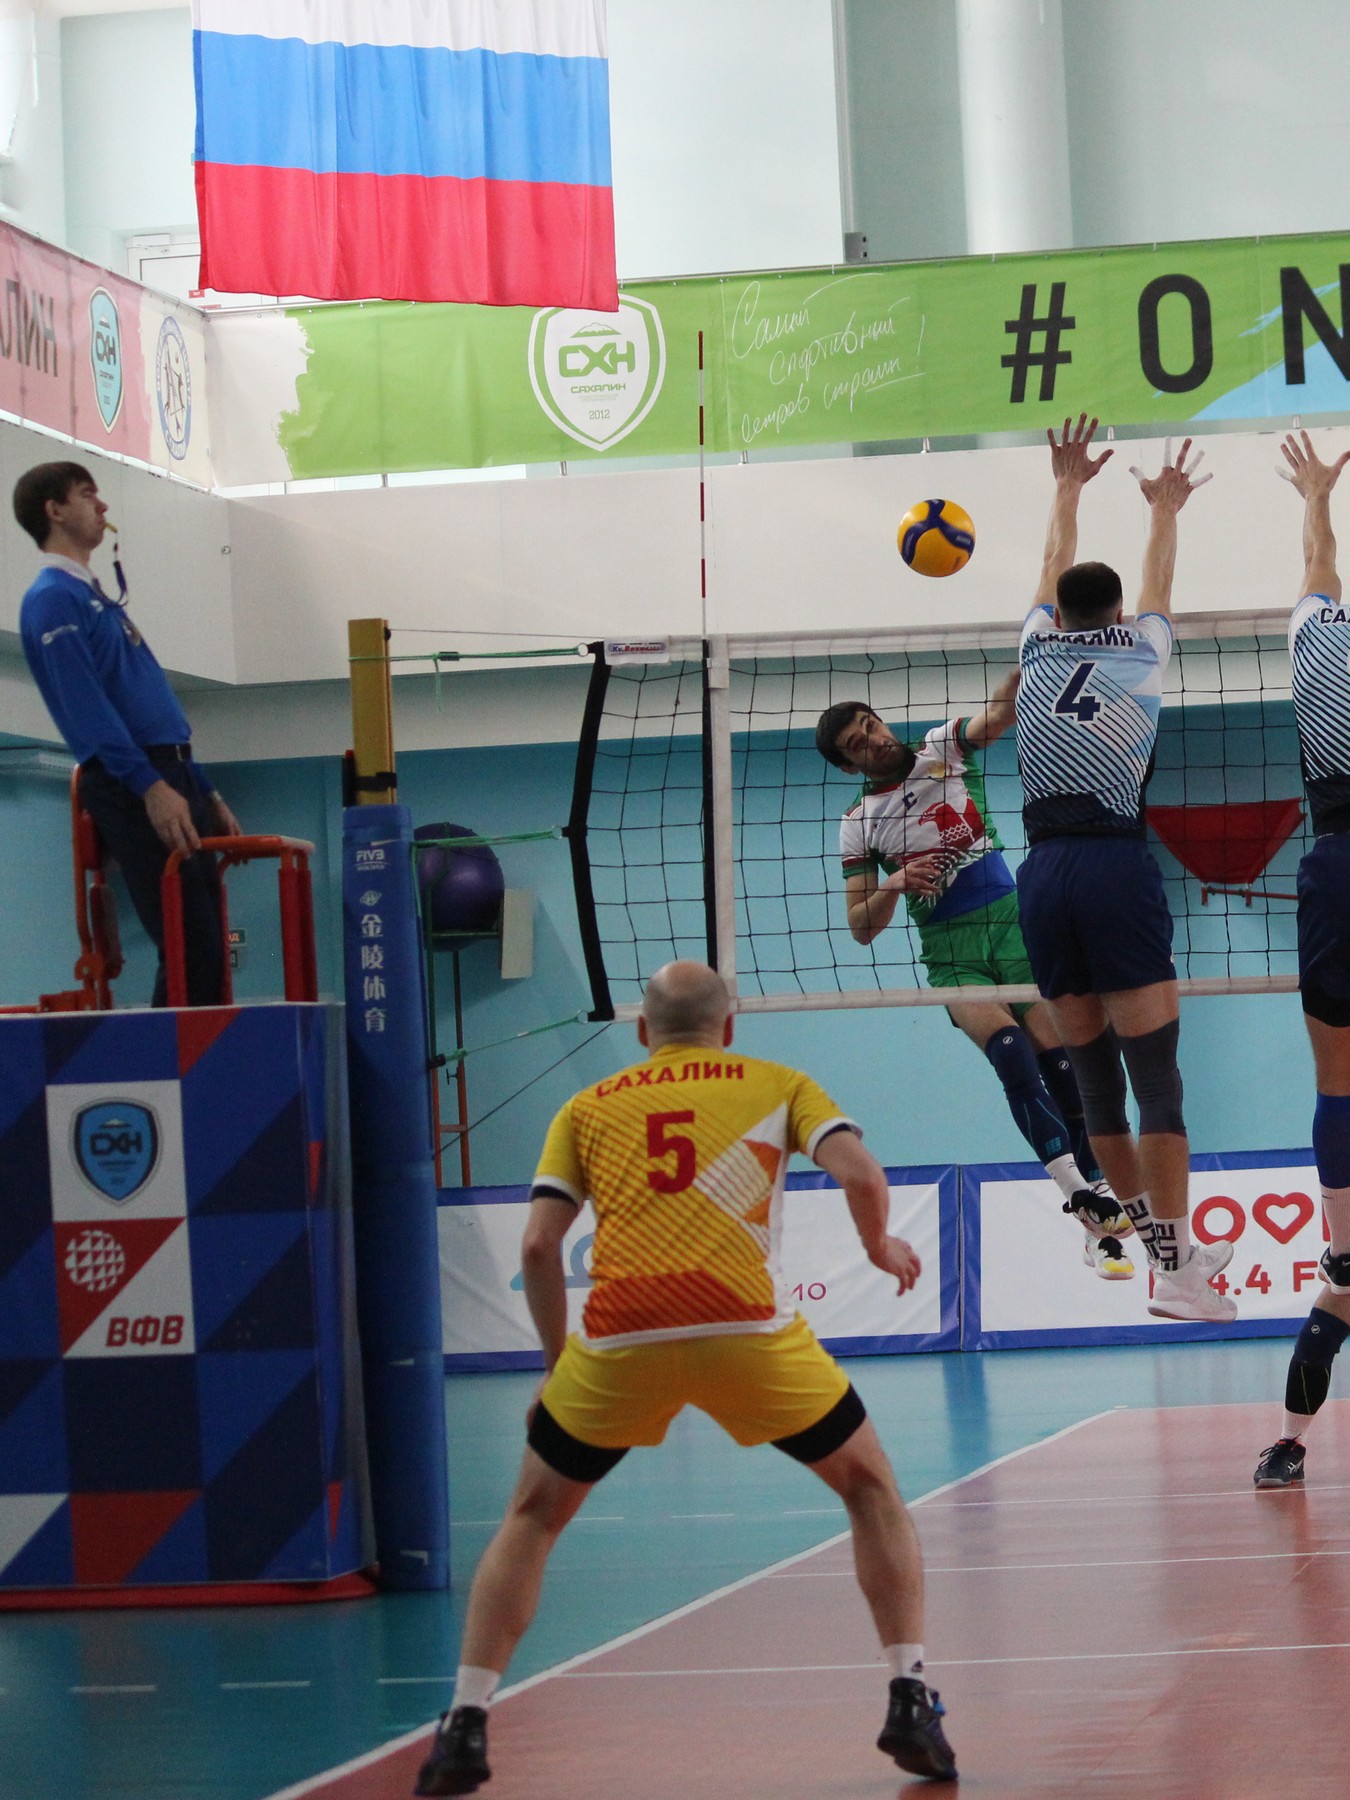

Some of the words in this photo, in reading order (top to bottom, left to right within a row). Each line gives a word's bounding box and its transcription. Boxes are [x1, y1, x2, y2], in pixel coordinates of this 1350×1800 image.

[588, 409, 611, 420] 2012
[1054, 662, 1101, 722] 4
[596, 1061, 745, 1098] САХАЛИН
[646, 1109, 697, 1195] 5
[105, 1314, 184, 1347] ВФВ
